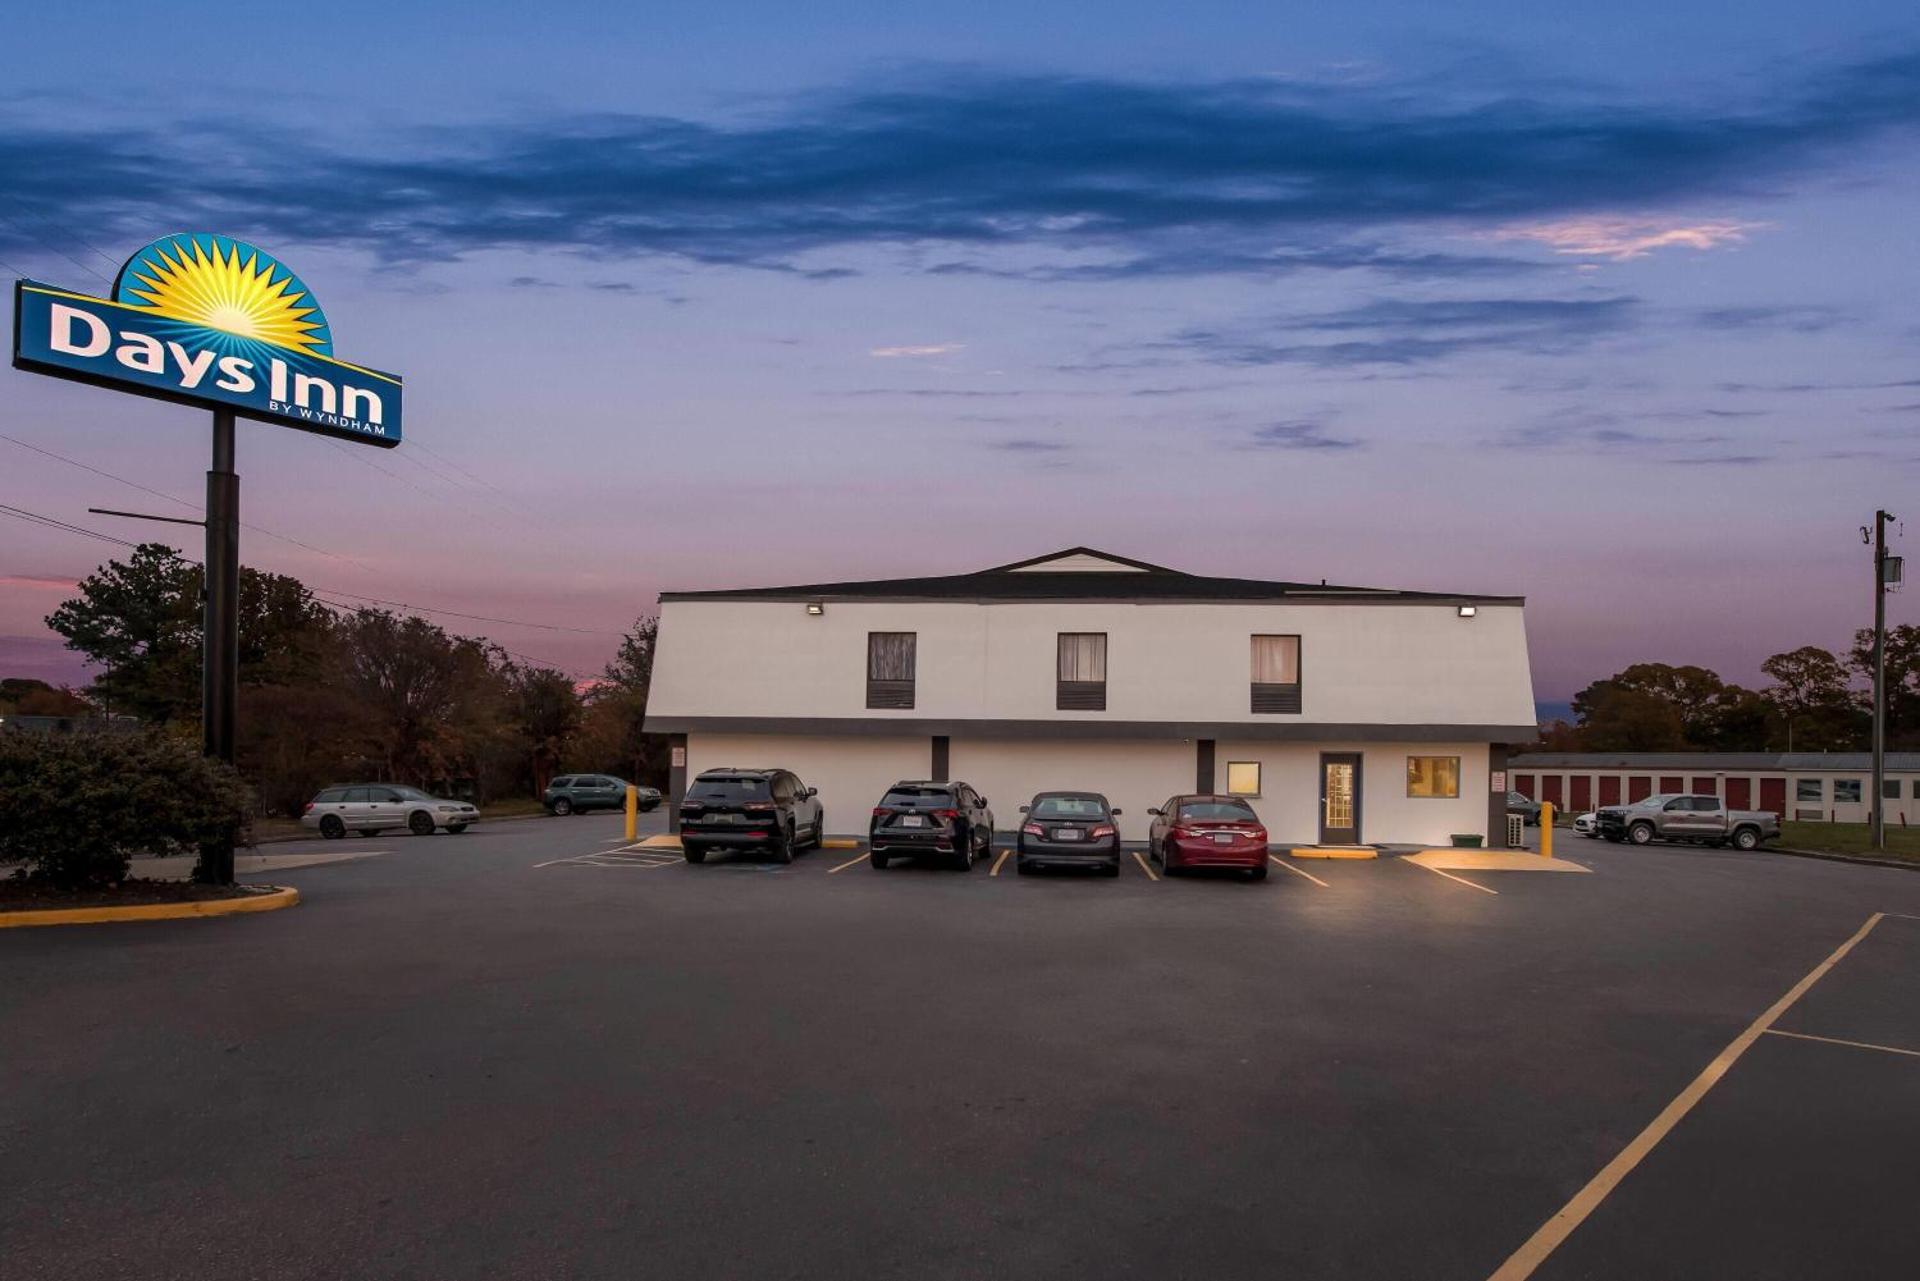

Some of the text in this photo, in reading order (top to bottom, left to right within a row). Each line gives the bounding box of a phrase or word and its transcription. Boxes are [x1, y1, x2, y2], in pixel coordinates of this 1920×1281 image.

[50, 302, 383, 425] Days Inn
[269, 400, 386, 436] BY WYNDHAM
